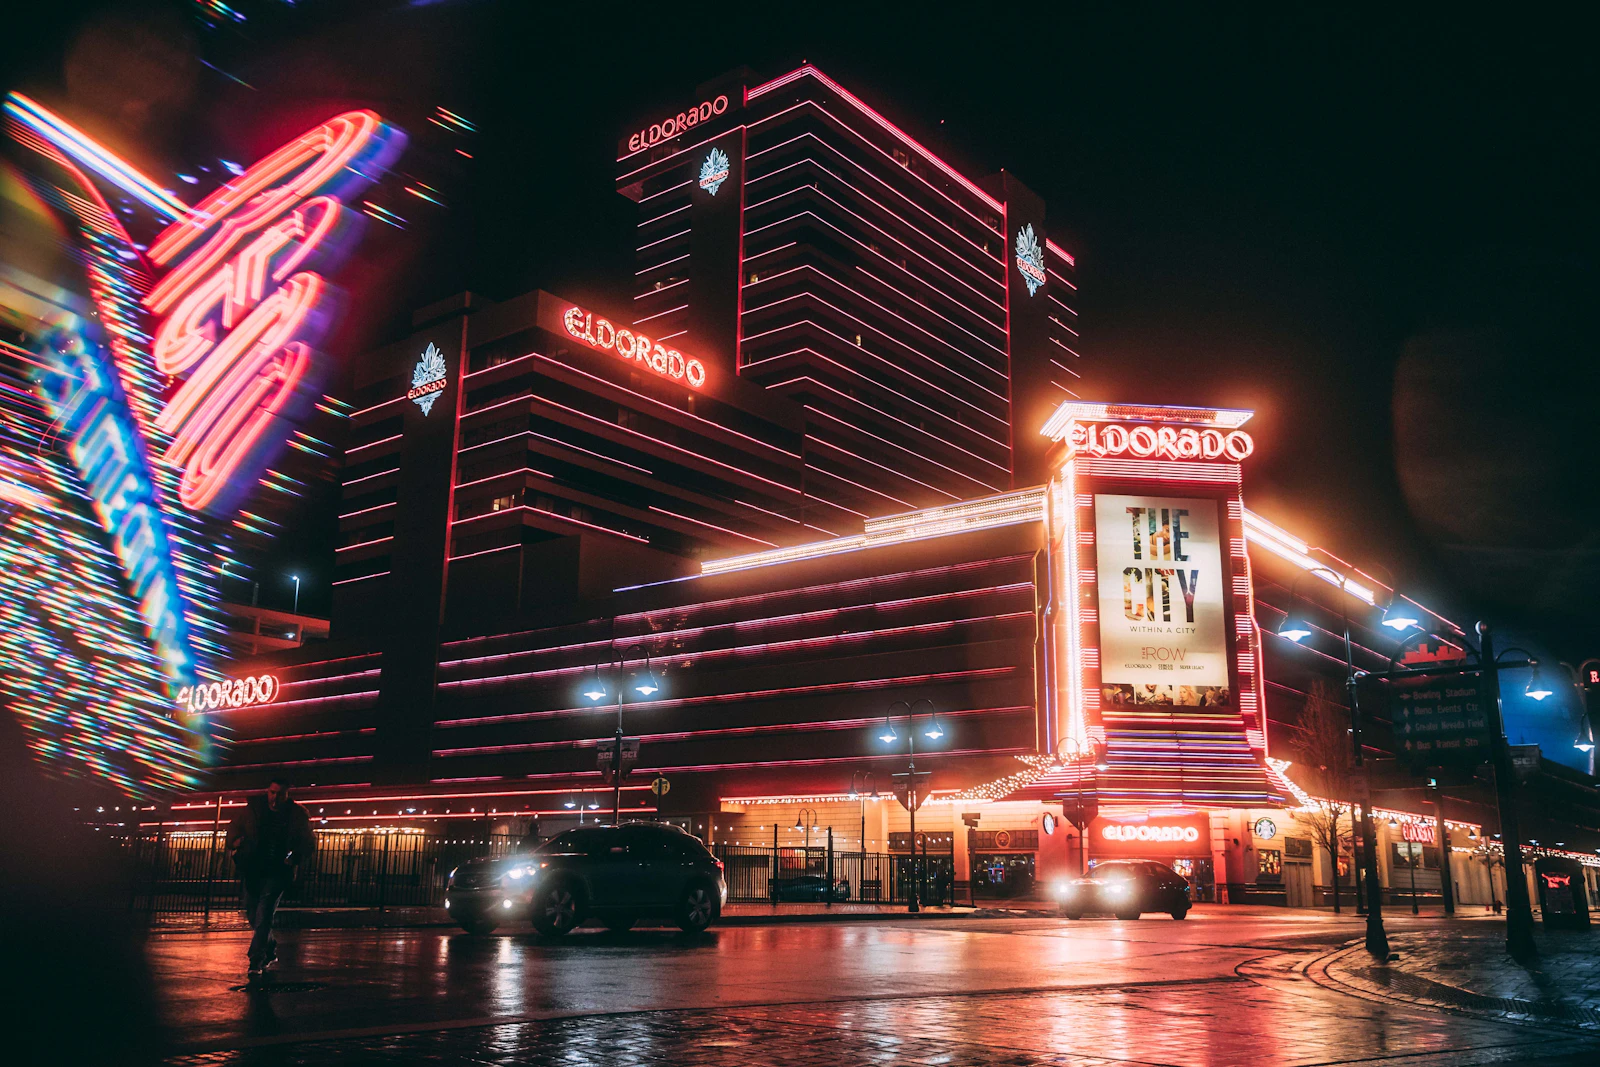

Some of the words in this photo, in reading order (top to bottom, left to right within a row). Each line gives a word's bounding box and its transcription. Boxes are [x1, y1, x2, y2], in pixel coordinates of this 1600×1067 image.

[628, 95, 729, 152] ELDORADO
[563, 306, 706, 388] ELDORADO
[407, 379, 447, 399] ELDORADO
[1065, 423, 1254, 462] ELDORADO
[1125, 506, 1191, 562] THE
[1122, 566, 1199, 623] CITY
[1146, 646, 1186, 661] ROW
[1413, 690, 1441, 700] Bowling
[1445, 687, 1477, 698] Stadium
[1414, 706, 1432, 715] Reno
[1437, 704, 1462, 713] Events
[1466, 703, 1478, 712] Ctr
[1417, 740, 1431, 750] Bus
[598, 751, 613, 760] SCI
[621, 751, 638, 759] SCI
[1102, 825, 1198, 842] ELDORADO
